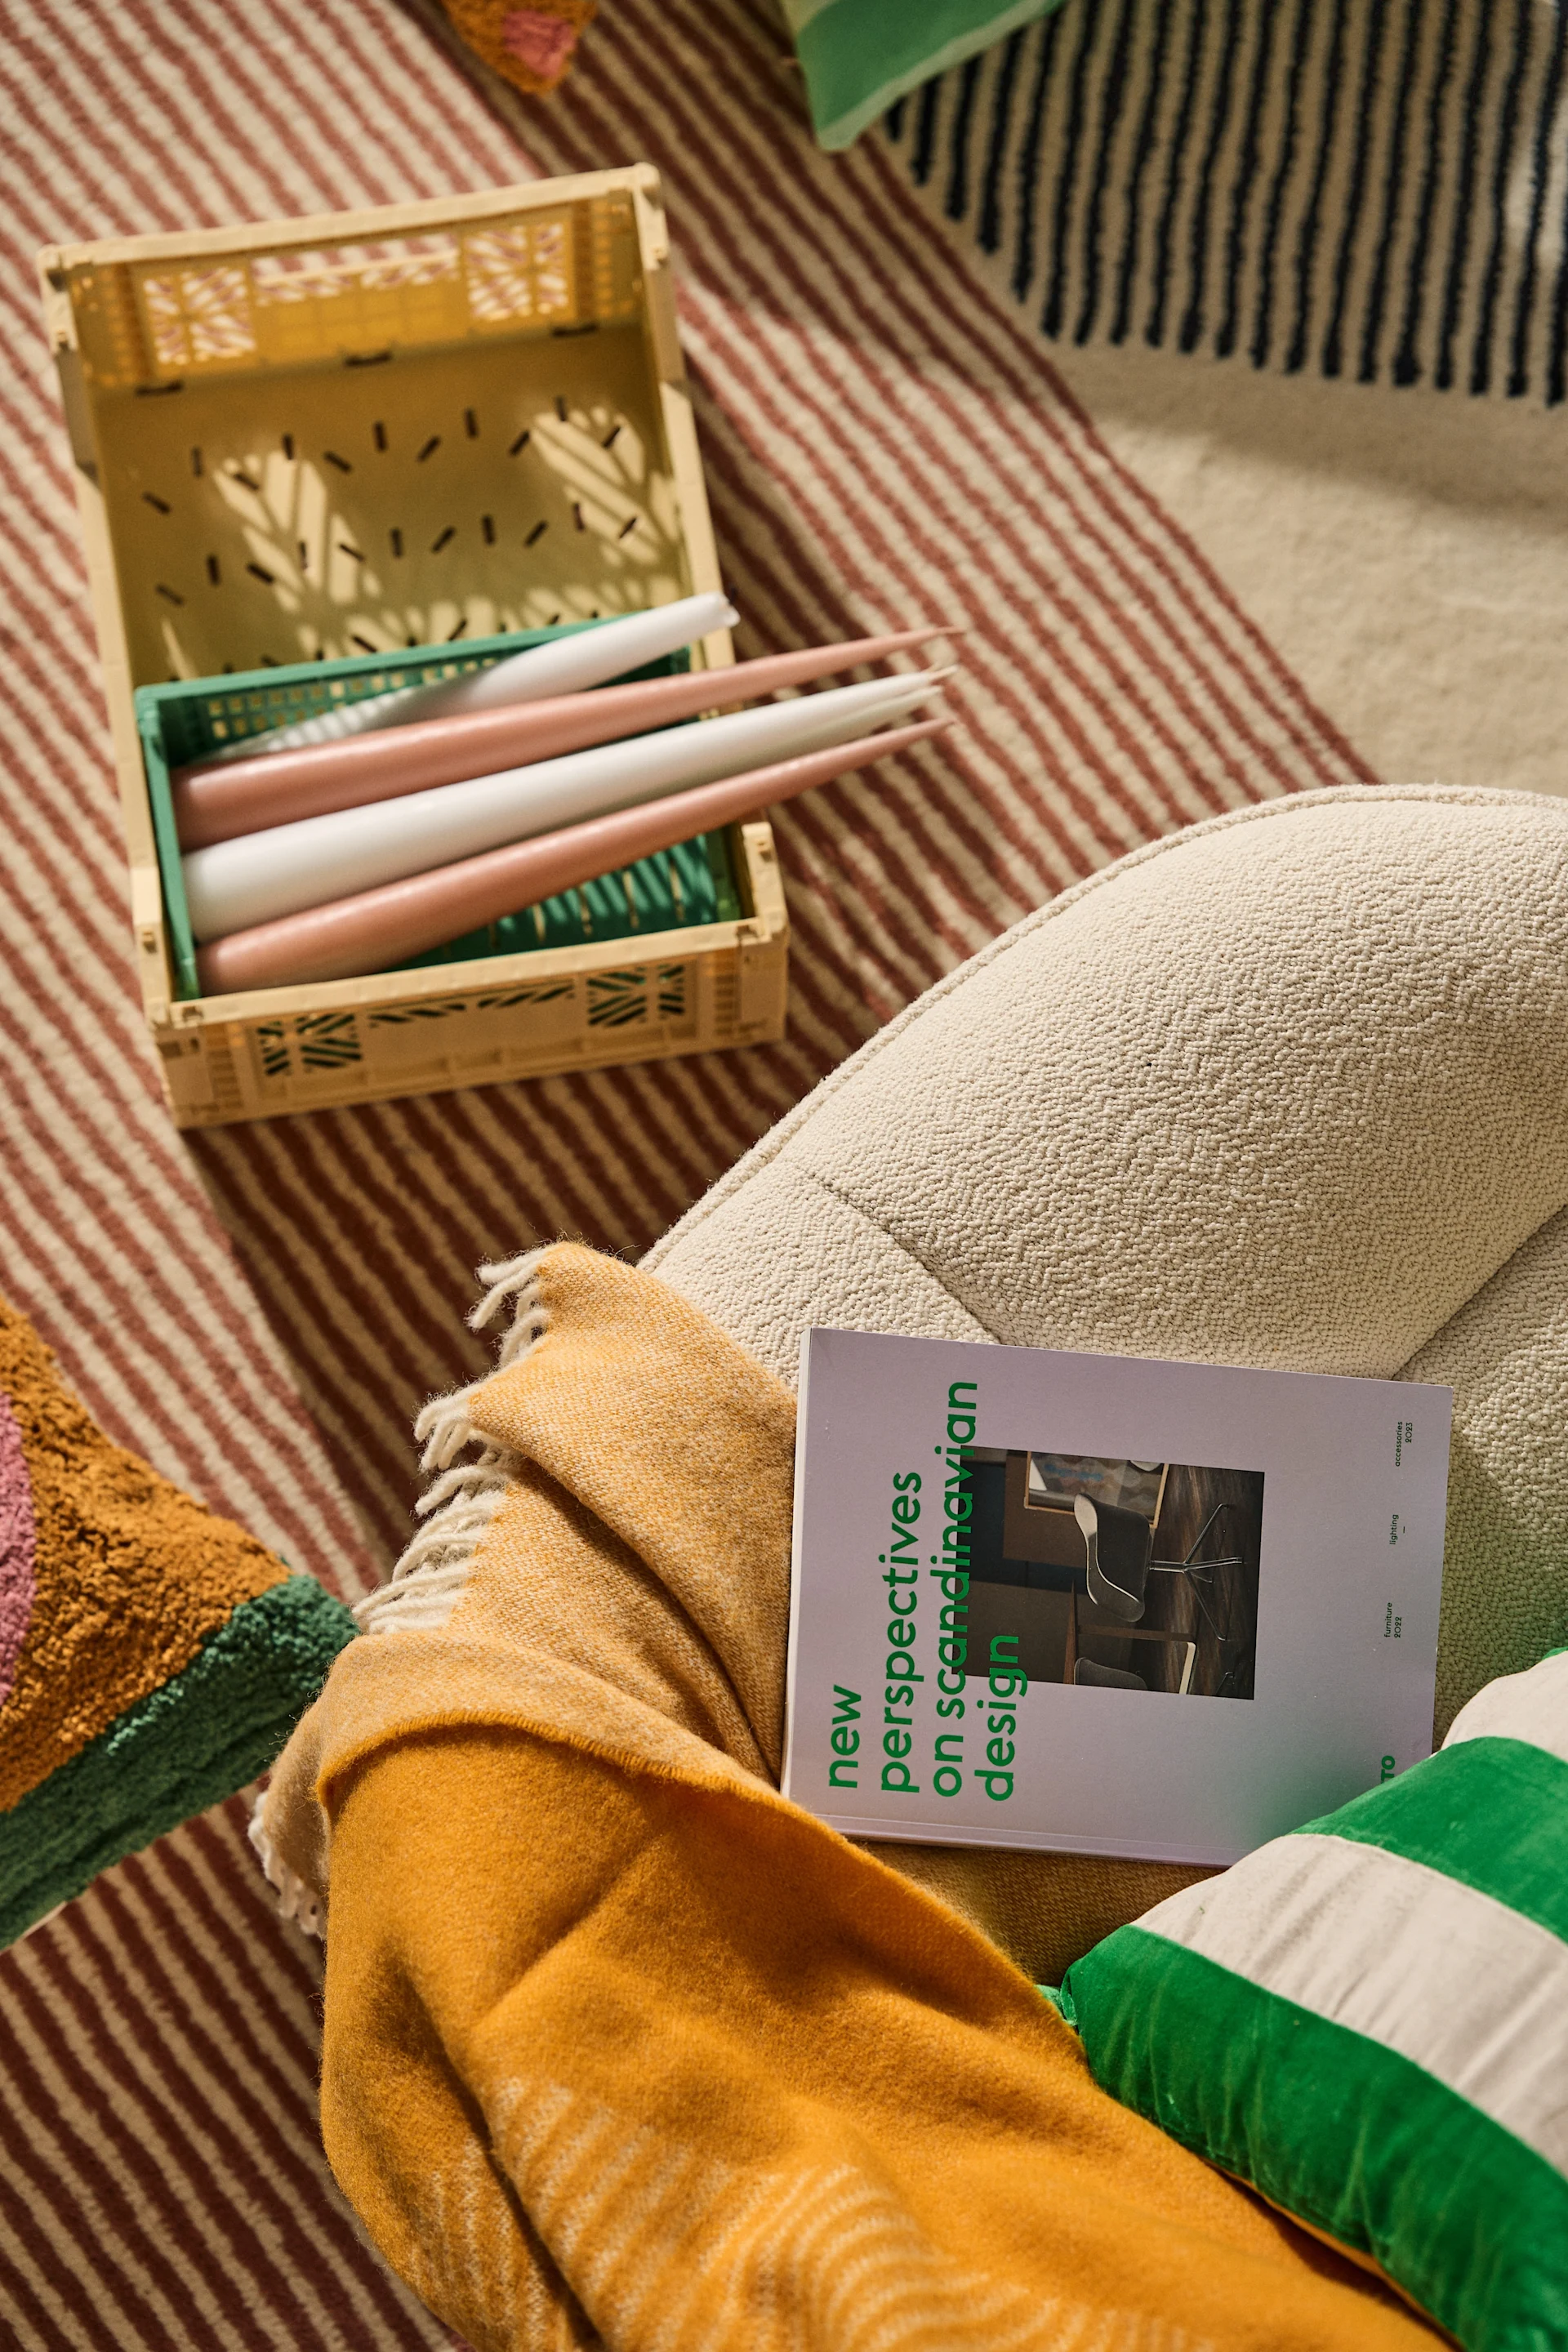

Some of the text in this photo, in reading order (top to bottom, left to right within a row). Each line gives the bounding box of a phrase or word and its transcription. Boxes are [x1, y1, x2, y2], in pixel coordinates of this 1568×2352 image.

[1395, 1421, 1403, 1468] accessories
[1404, 1422, 1413, 1444] 2023
[1388, 1513, 1400, 1545] lighting
[929, 1381, 978, 1797] on scandinavian
[878, 1472, 924, 1793] perspectives
[1383, 1601, 1393, 1638] furniture
[1393, 1616, 1402, 1639] 2022
[828, 1685, 862, 1788] new
[973, 1634, 1028, 1802] design
[1380, 1755, 1395, 1784] TO
